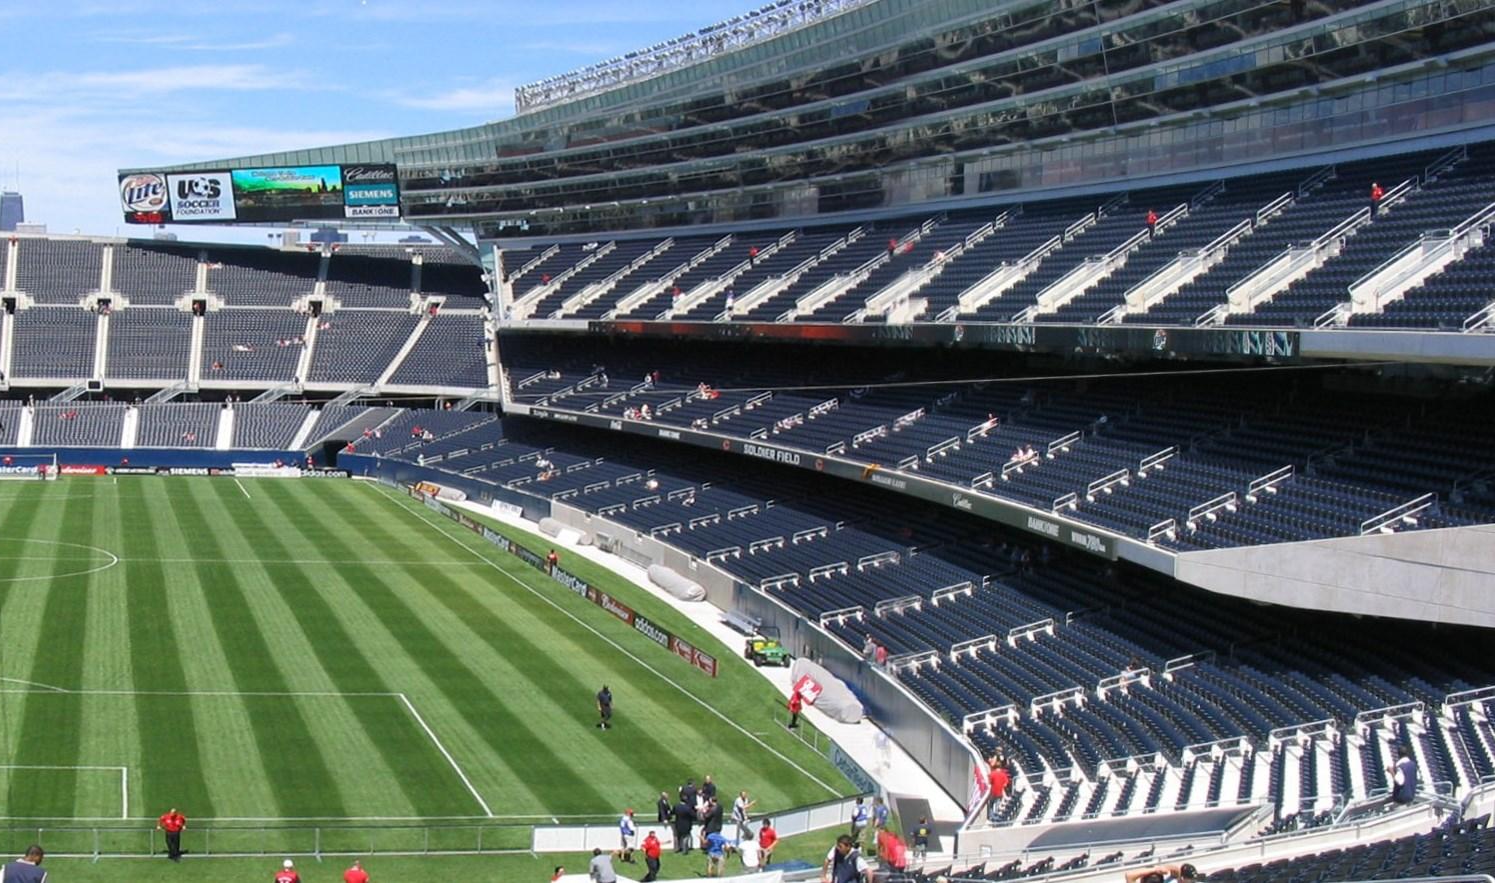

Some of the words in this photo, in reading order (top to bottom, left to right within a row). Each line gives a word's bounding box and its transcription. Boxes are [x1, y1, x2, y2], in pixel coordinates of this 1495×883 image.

[344, 167, 393, 182] Cadillac
[349, 189, 393, 199] SIEMENS
[177, 200, 220, 208] SOCCER
[176, 208, 221, 216] FOUNDATION
[744, 443, 775, 460] SOLDIER
[776, 450, 801, 465] FIELD
[169, 467, 209, 476] SIEMENS
[551, 565, 587, 597] MasterCard
[634, 616, 669, 647] adidas.com
